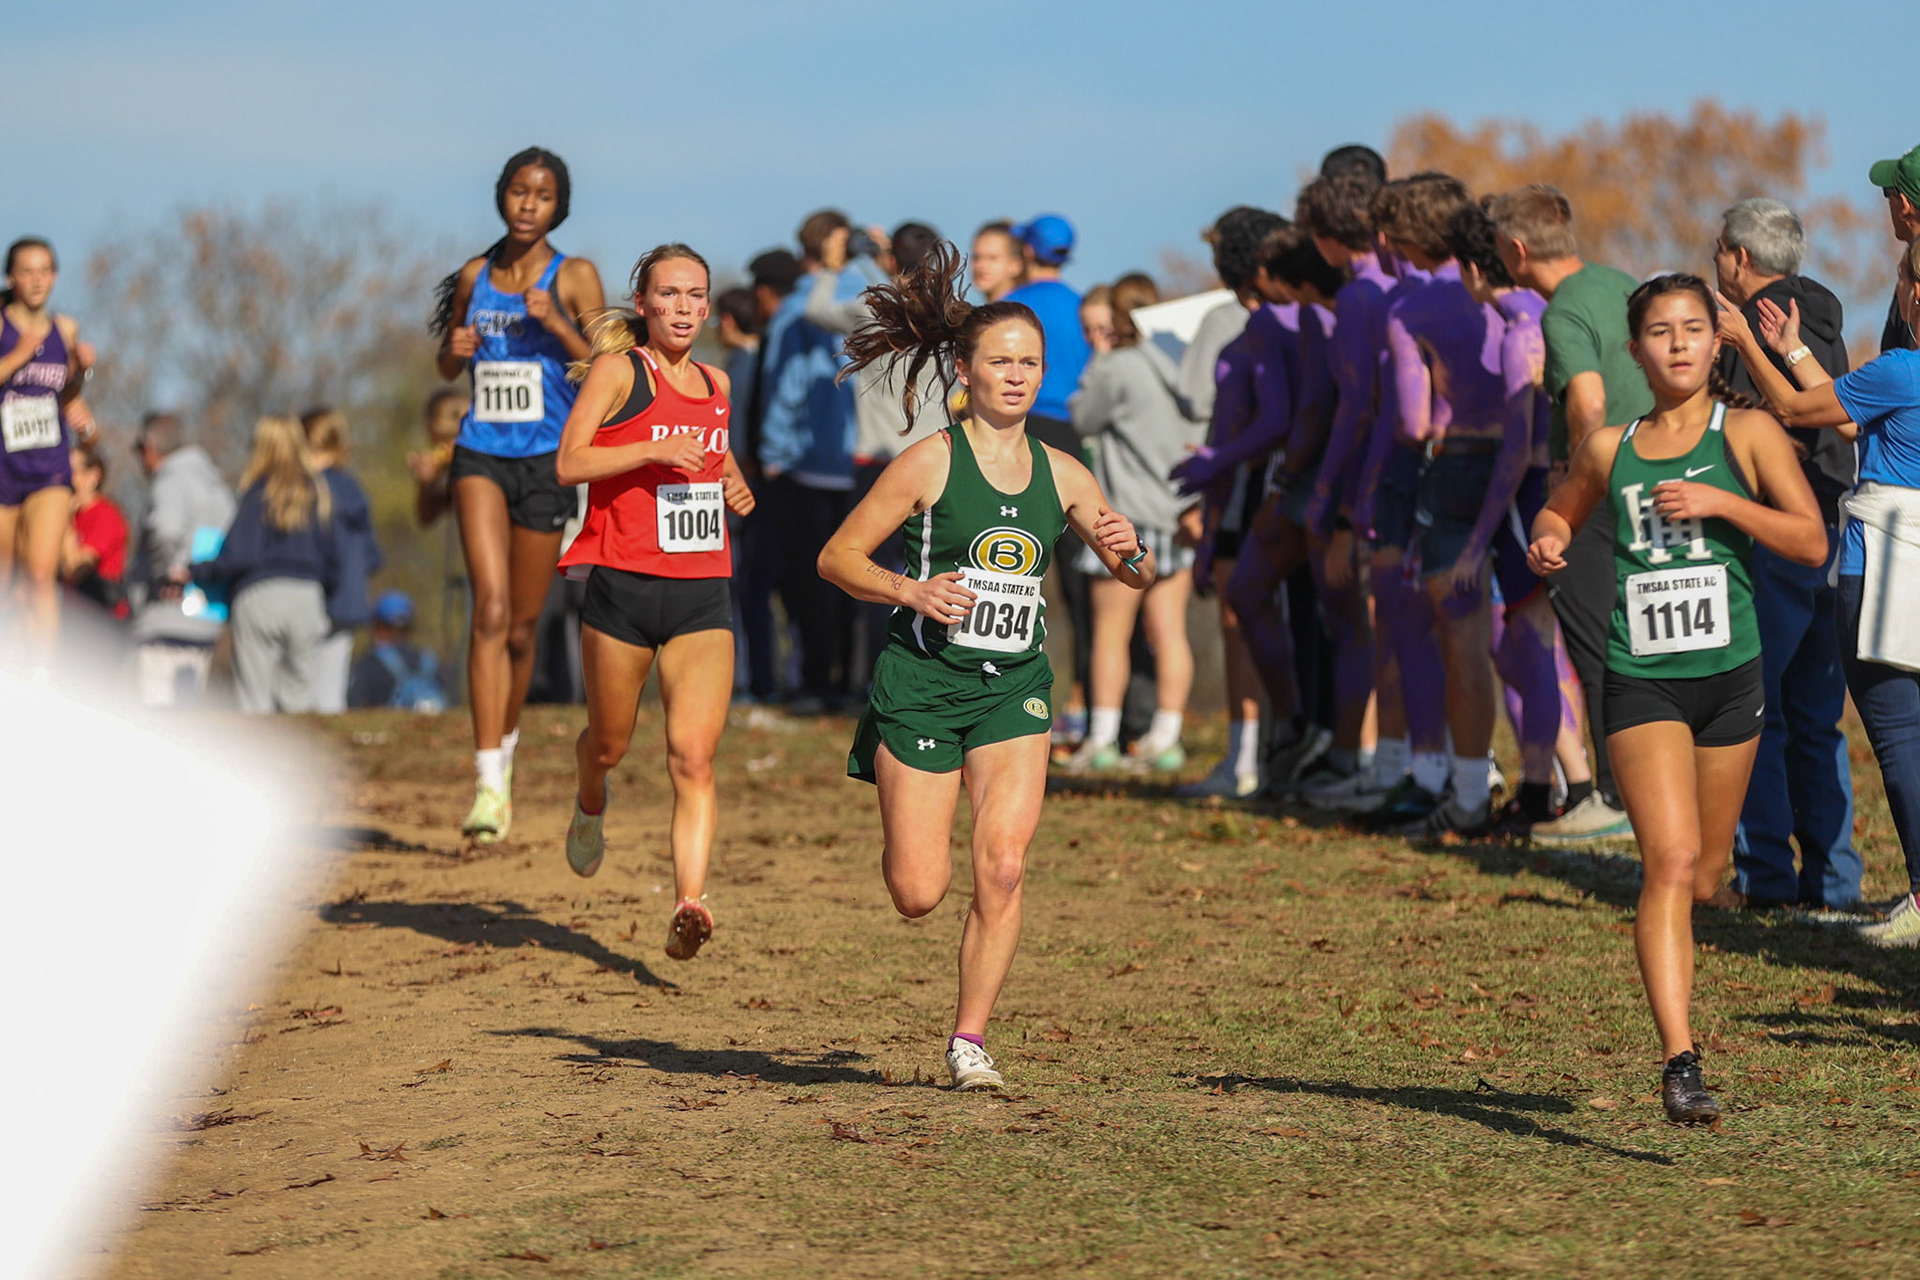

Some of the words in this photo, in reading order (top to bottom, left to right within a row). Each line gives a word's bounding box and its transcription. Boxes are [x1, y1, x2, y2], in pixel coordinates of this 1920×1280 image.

[483, 385, 530, 411] 1110
[664, 508, 720, 540] 1004
[968, 577, 1000, 593] TMSAA
[1001, 583, 1024, 596] STATE
[1024, 585, 1036, 597] XC
[1637, 580, 1670, 594] TMSAA
[1672, 577, 1702, 591] STATE
[1704, 575, 1717, 587] XC
[961, 600, 1032, 641] 1034
[1641, 597, 1716, 641] 1114
